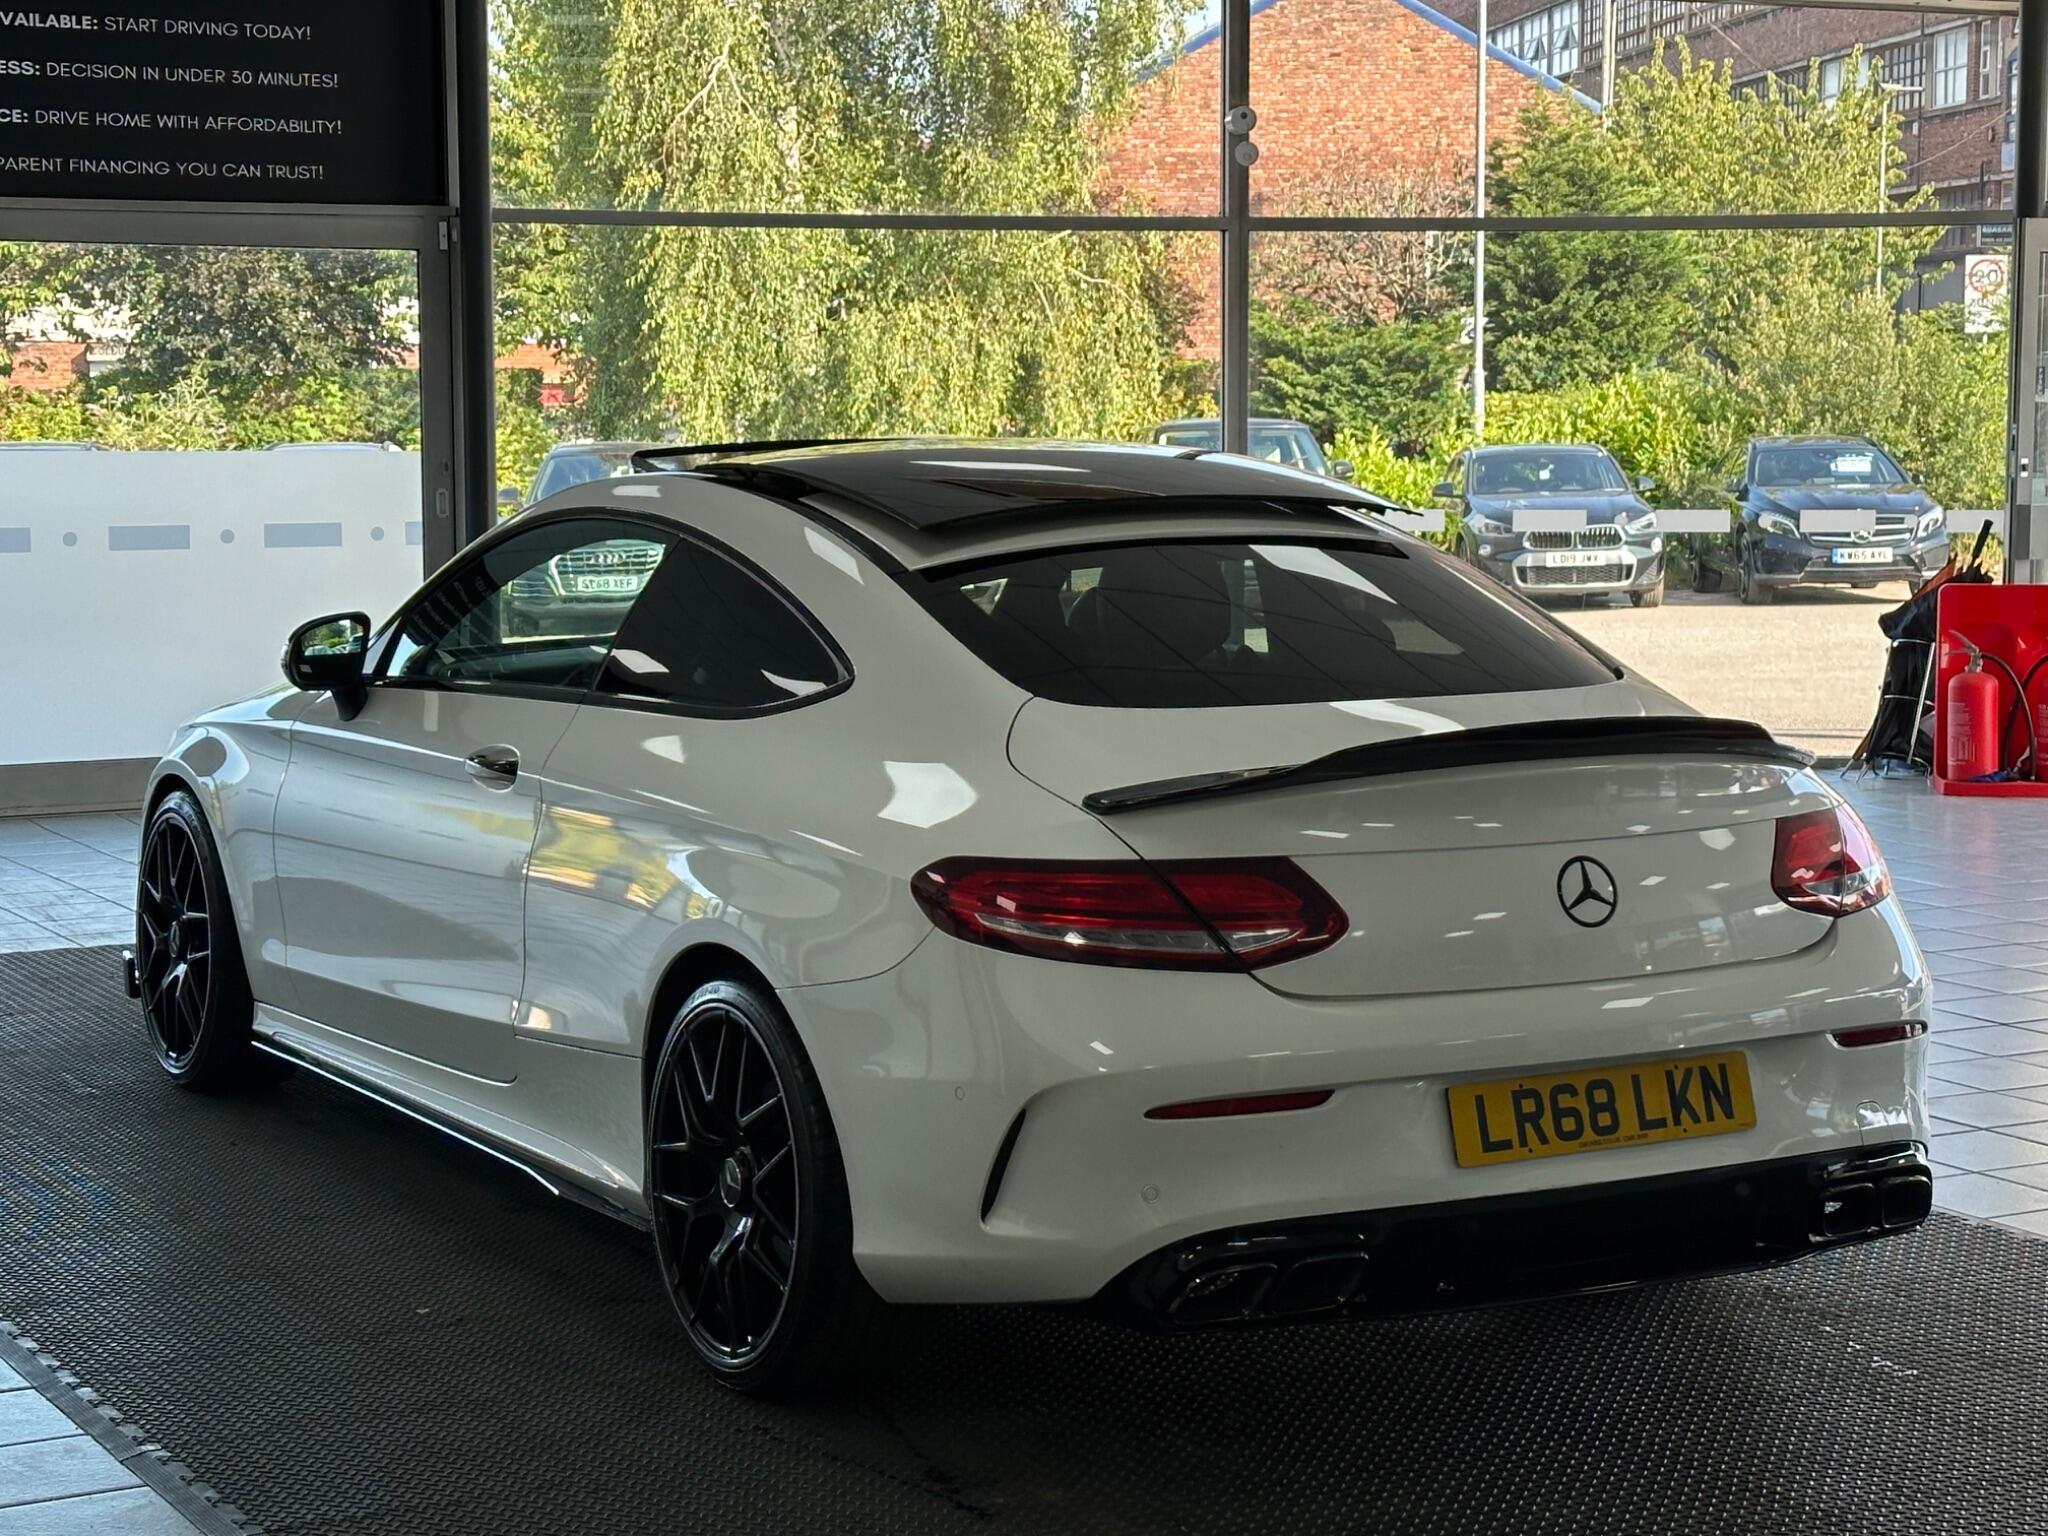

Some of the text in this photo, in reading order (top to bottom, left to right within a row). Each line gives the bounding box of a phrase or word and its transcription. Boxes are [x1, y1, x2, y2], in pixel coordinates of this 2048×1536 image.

[104, 16, 158, 33] START
[164, 19, 239, 37] DRIVING
[243, 23, 311, 41] TODAY!
[0, 59, 338, 88] ESS: DECISION IN UNDER 30 MINUTES!
[0, 108, 342, 135] CE: DRIVE HOME WITH AFFORDABILITY!
[69, 158, 170, 175] FINANCING
[176, 162, 217, 177] YOU
[222, 163, 261, 178] CAN
[266, 164, 323, 180] TRUST!
[1975, 269, 1998, 284] 20
[1473, 1062, 1735, 1154] LR68 LKN
